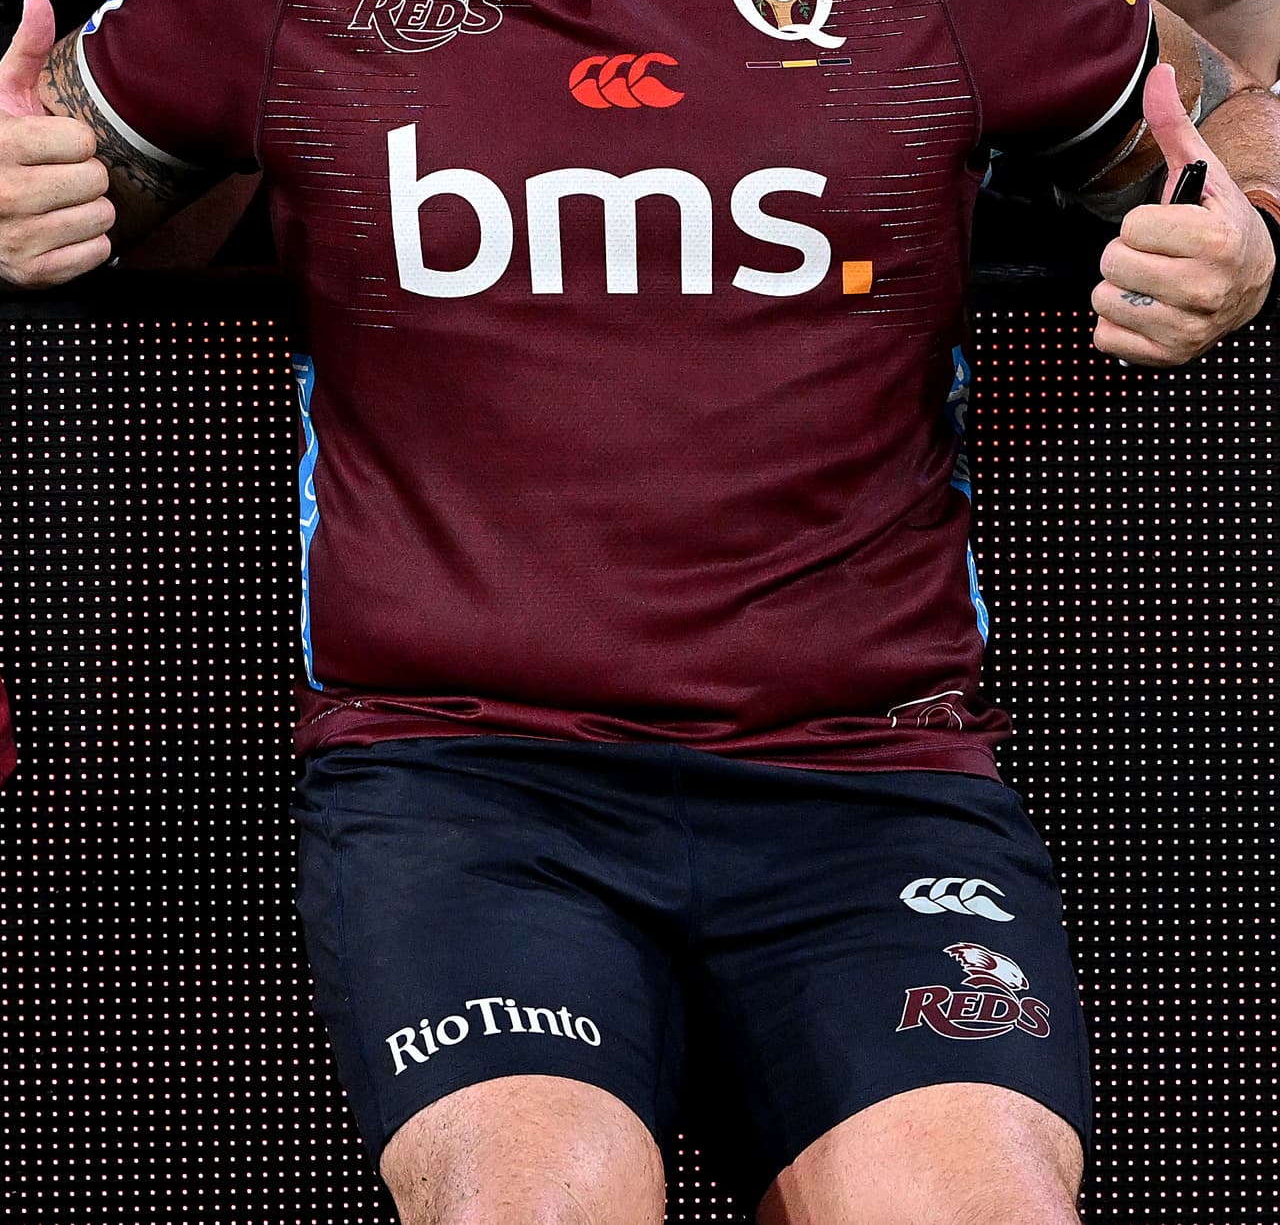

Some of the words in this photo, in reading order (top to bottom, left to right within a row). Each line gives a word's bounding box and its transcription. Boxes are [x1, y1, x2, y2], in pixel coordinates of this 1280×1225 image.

[386, 1014, 470, 1076] Rio
[465, 997, 601, 1047] Tinto
[895, 985, 1051, 1041] REDS
